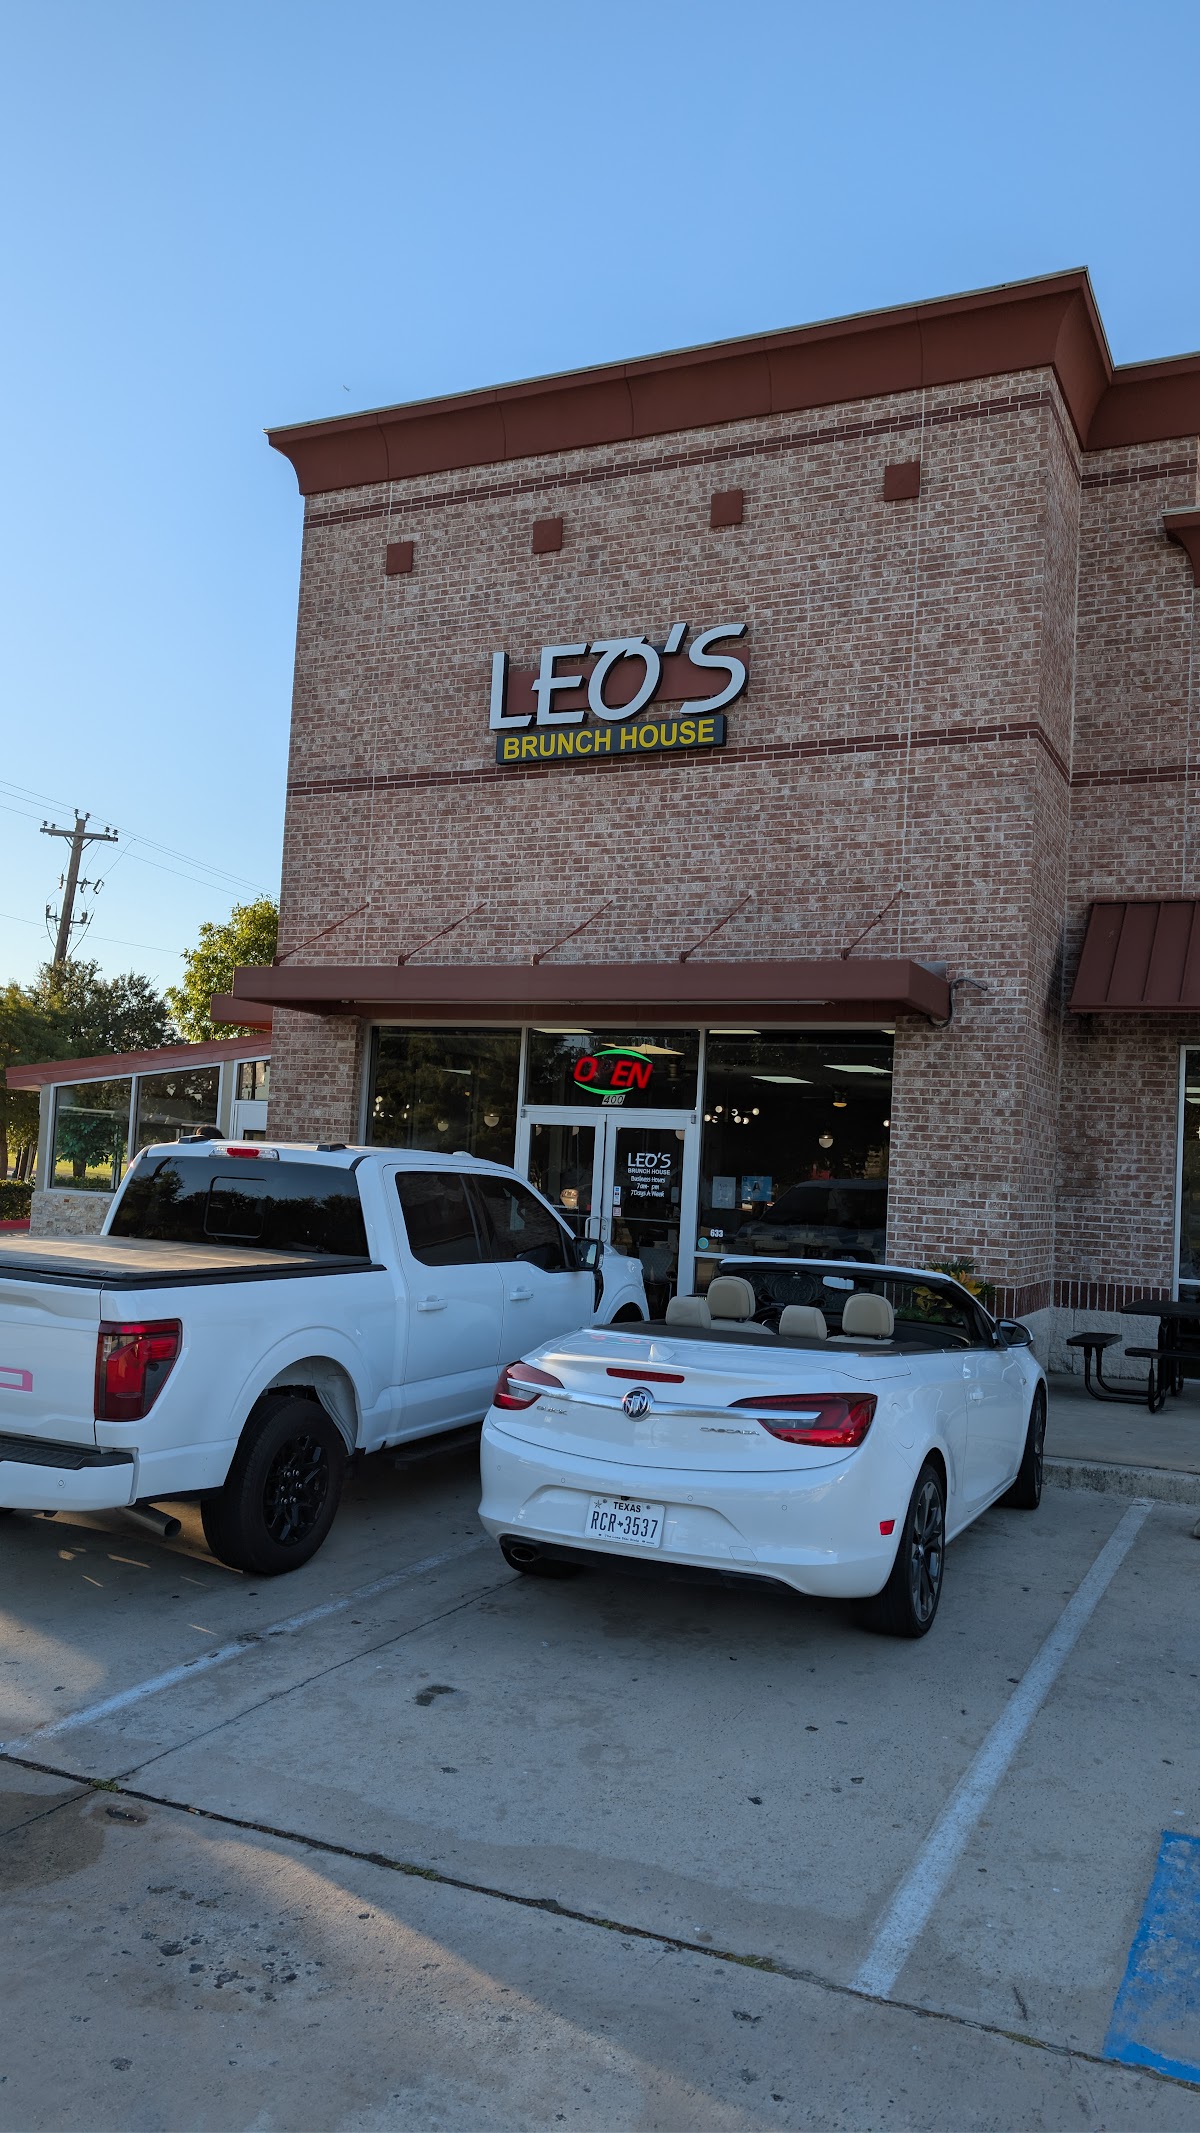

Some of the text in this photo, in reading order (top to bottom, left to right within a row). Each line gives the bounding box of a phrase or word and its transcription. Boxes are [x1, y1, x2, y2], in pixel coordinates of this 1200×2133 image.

[489, 622, 748, 730] LEO'S
[503, 718, 715, 760] BRUNCH HOUSE
[573, 1056, 654, 1089] OEN
[603, 1095, 624, 1104] 400
[627, 1152, 671, 1169] LEO'S
[710, 1229, 724, 1237] 633
[613, 1501, 641, 1513] TEXAS
